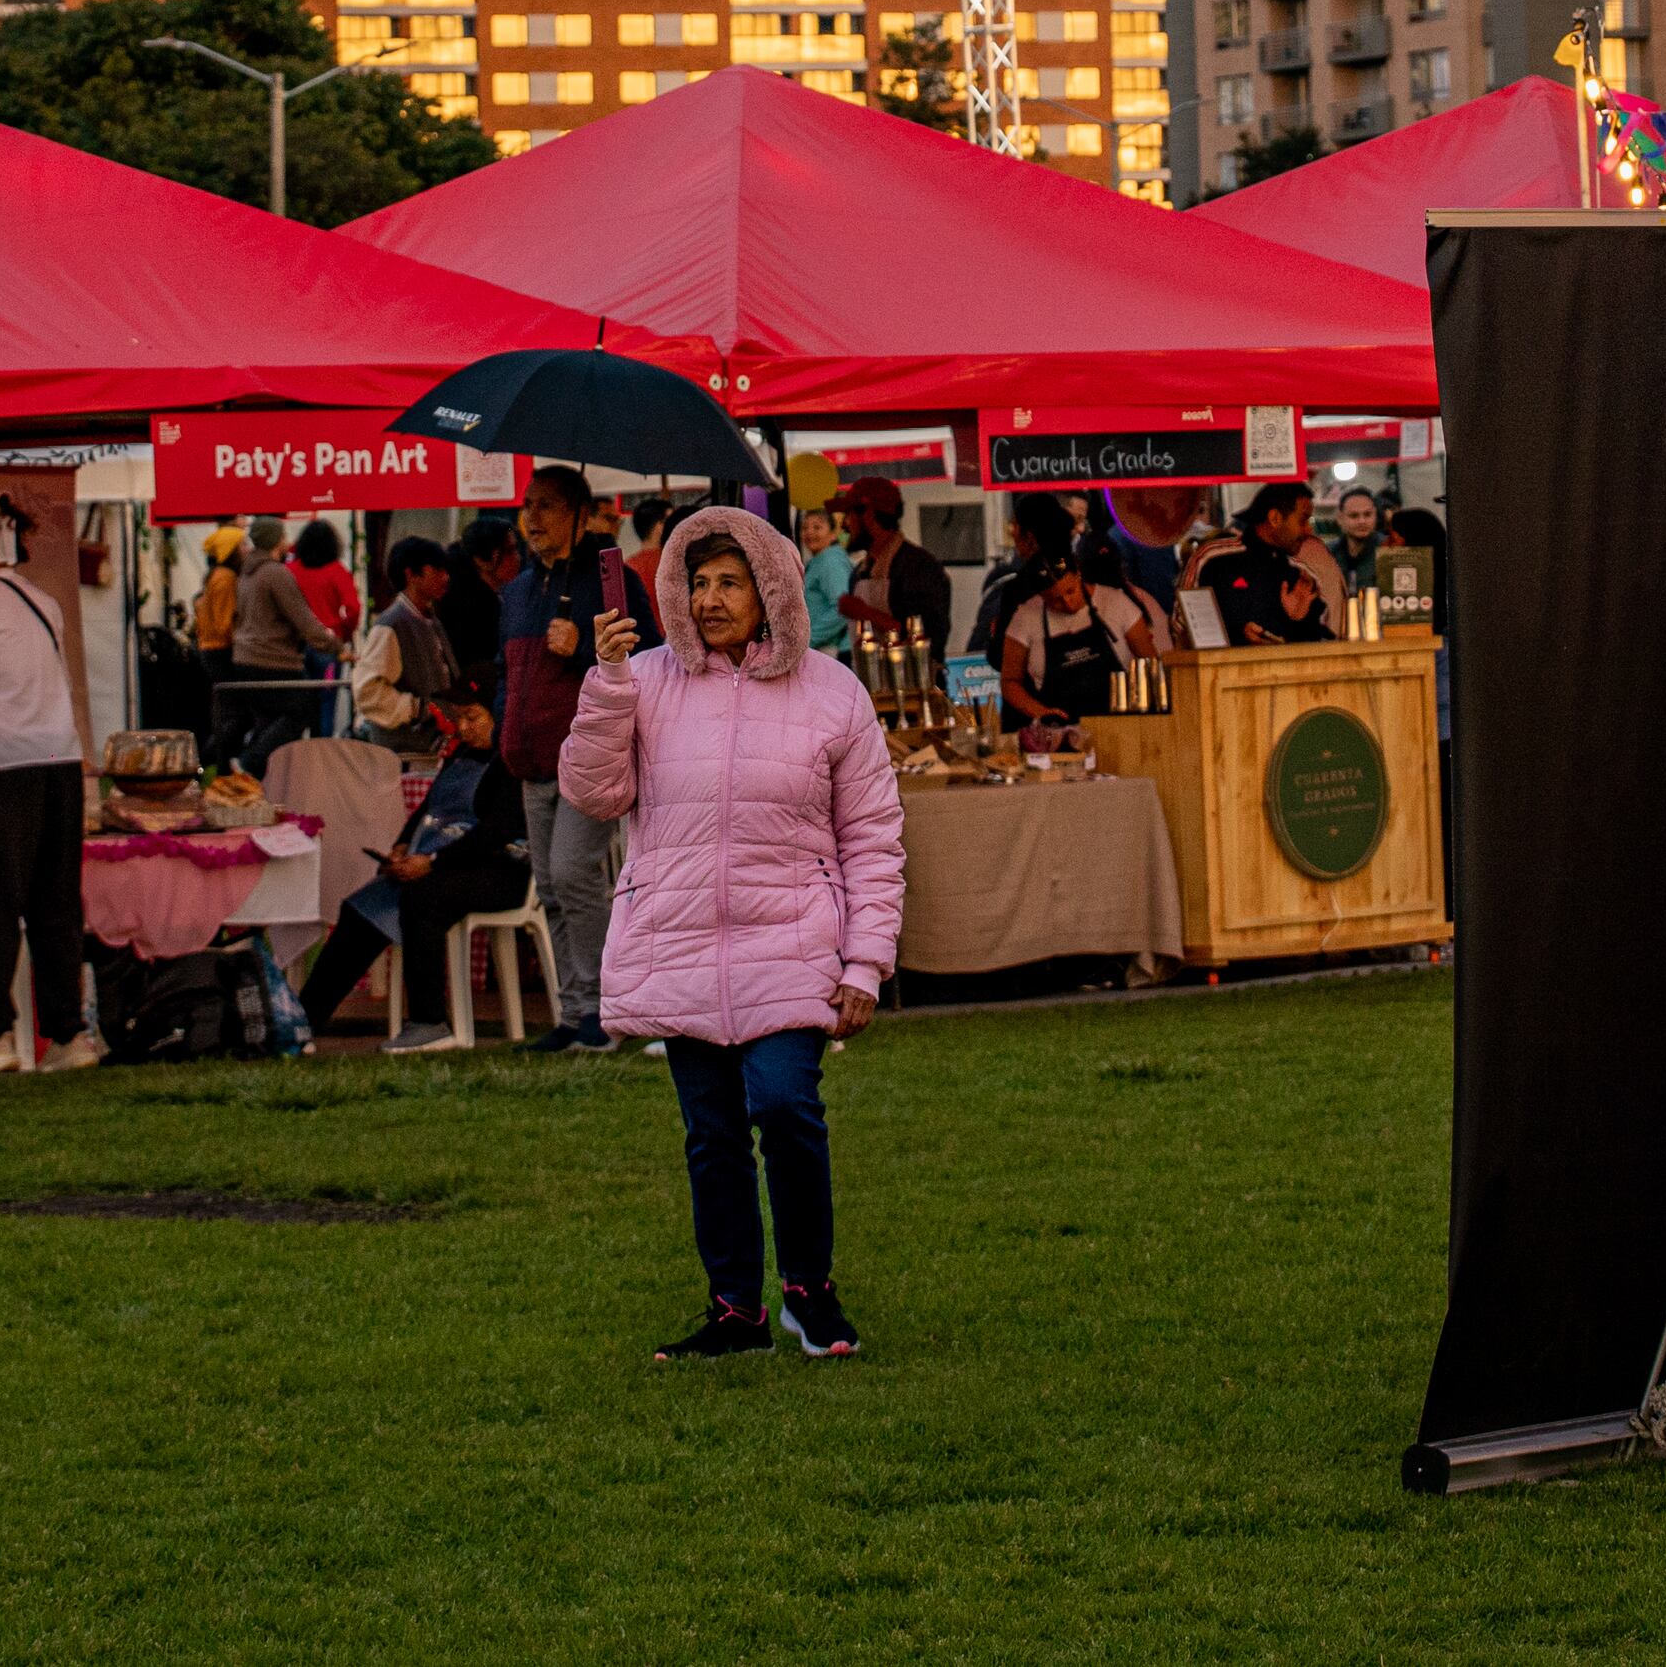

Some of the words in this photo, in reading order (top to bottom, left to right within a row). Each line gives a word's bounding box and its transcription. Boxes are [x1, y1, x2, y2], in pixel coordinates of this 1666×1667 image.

[433, 405, 482, 423] RENAULT
[214, 442, 307, 486] Paty's
[315, 442, 373, 476] Pan
[379, 440, 429, 474] Art
[992, 437, 1093, 480] Cuarenta
[1099, 437, 1175, 473] Grados
